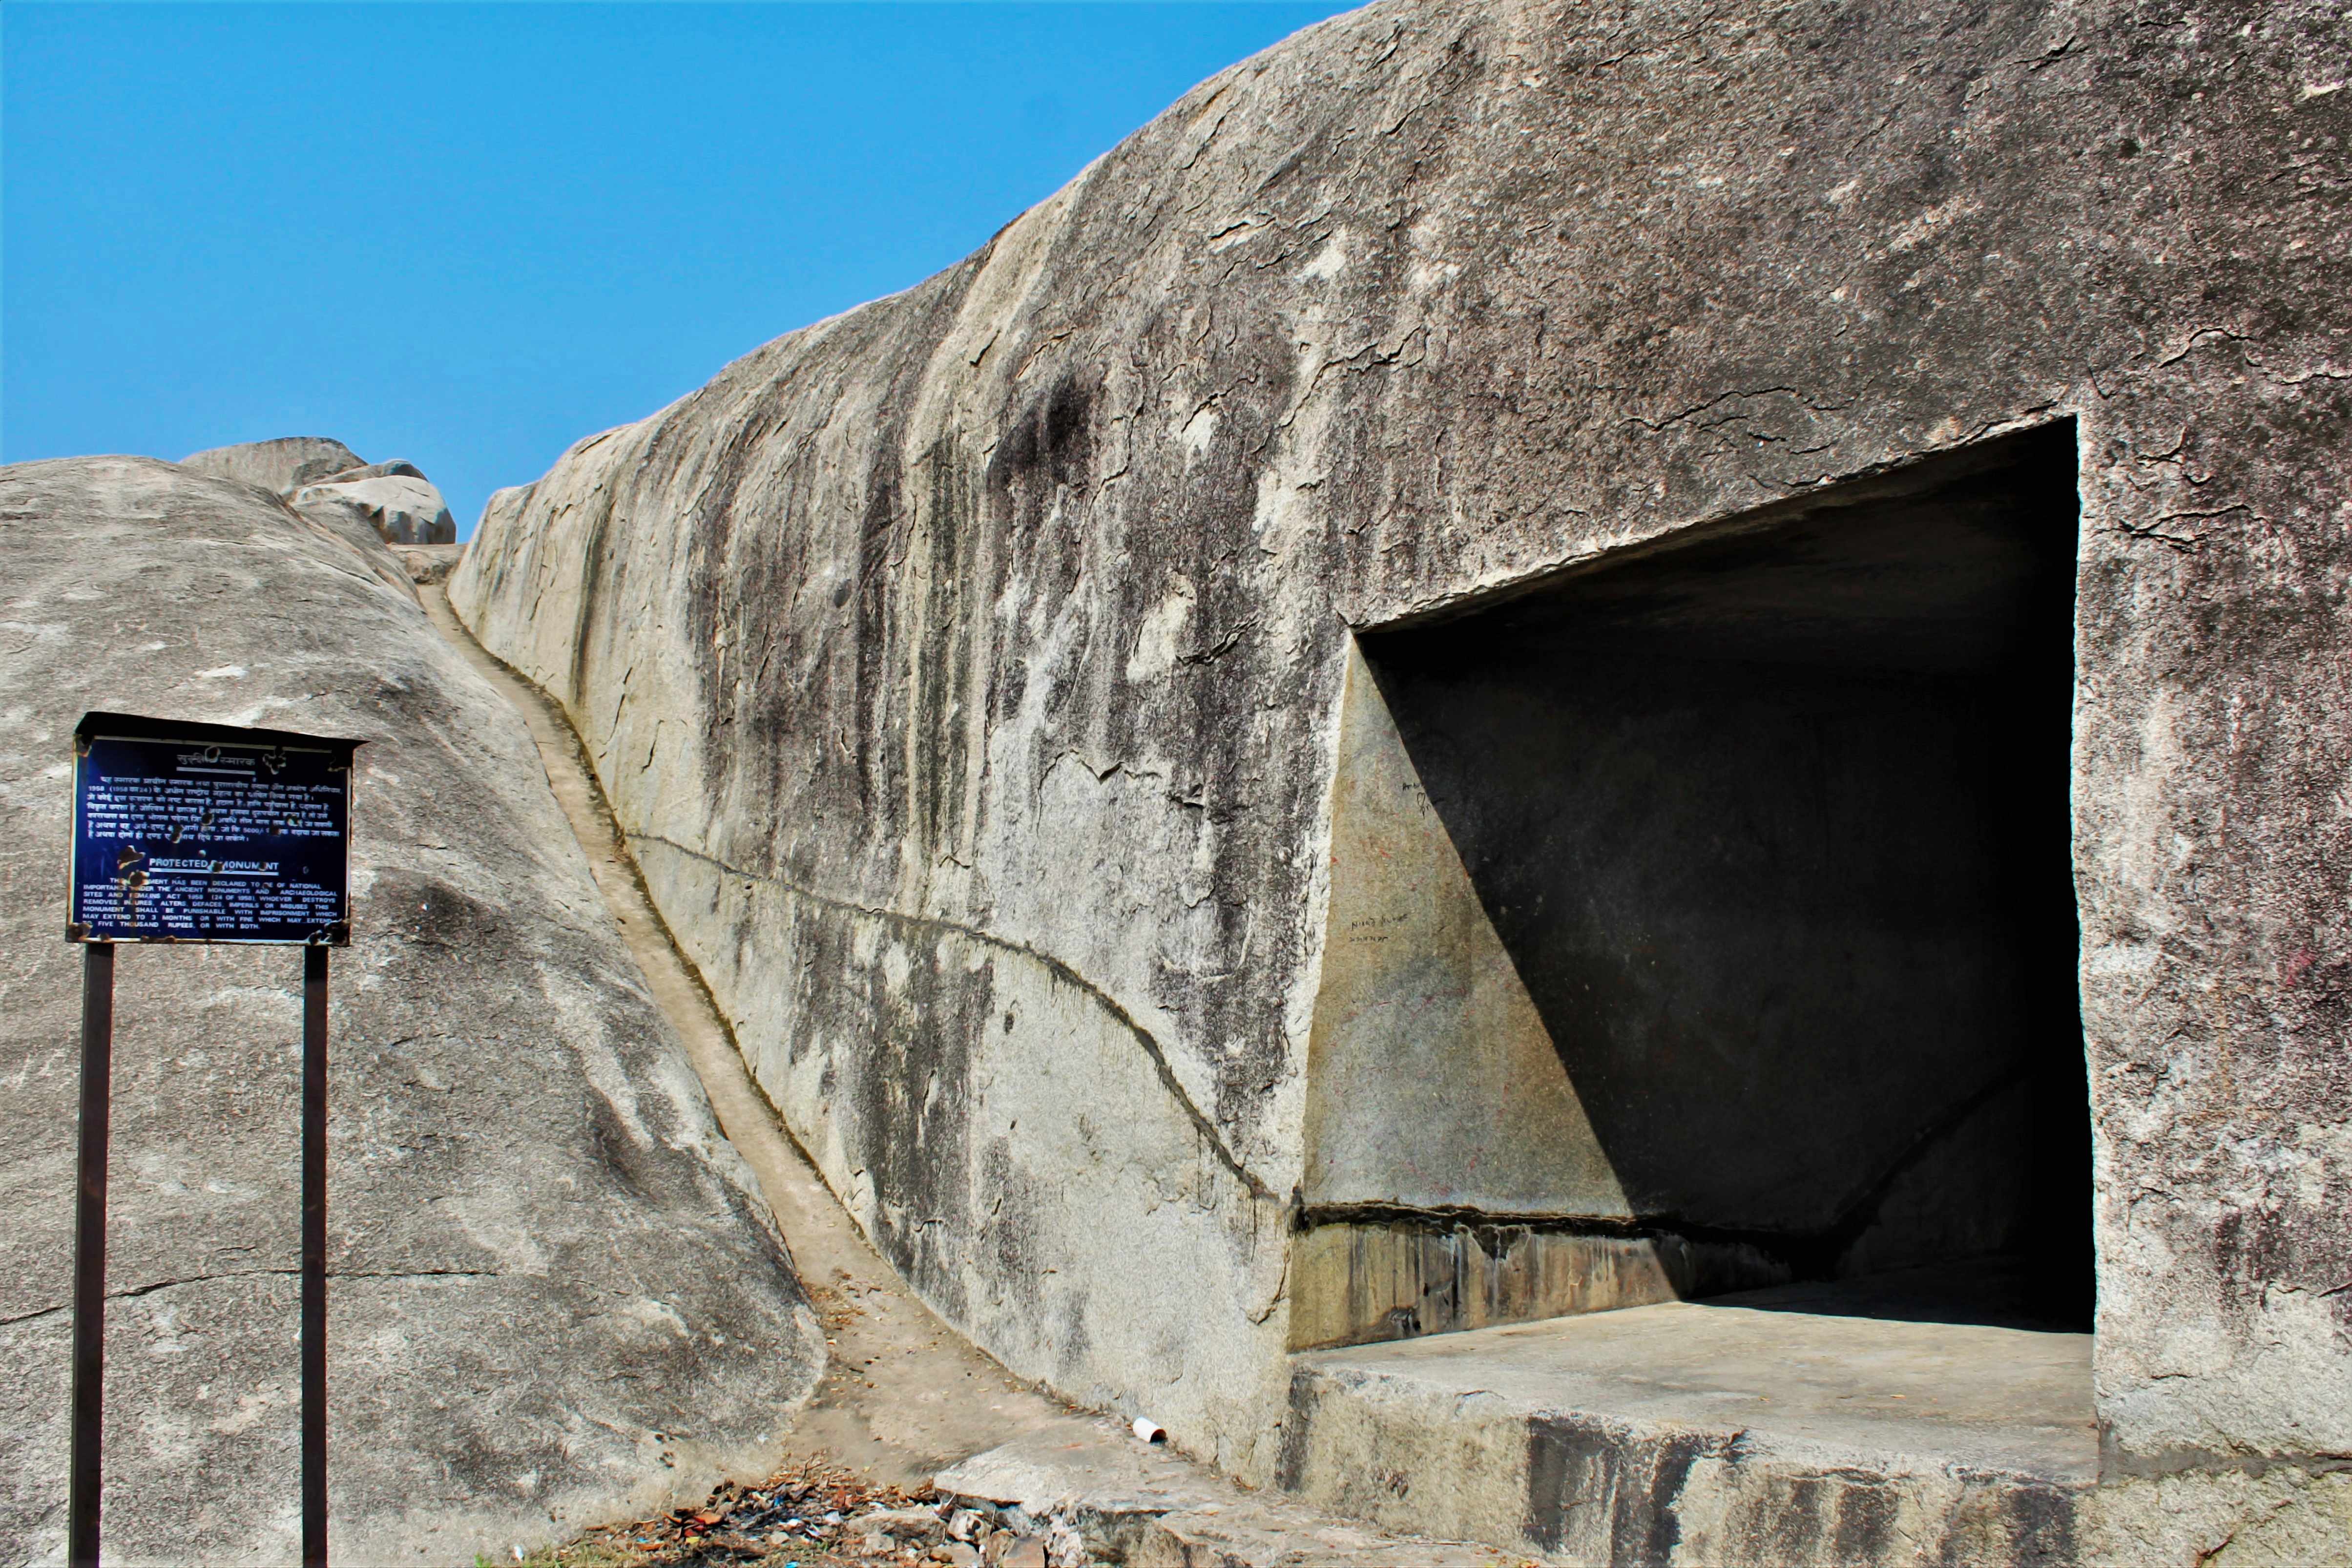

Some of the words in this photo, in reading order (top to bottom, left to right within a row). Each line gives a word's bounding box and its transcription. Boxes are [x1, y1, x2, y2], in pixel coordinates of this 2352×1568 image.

[177, 753, 216, 765] सुरक्षि
[220, 757, 255, 766] स्मारक
[97, 793, 112, 801] कोई
[148, 858, 208, 867] PROTECTED
[223, 860, 278, 869] MONUMNT
